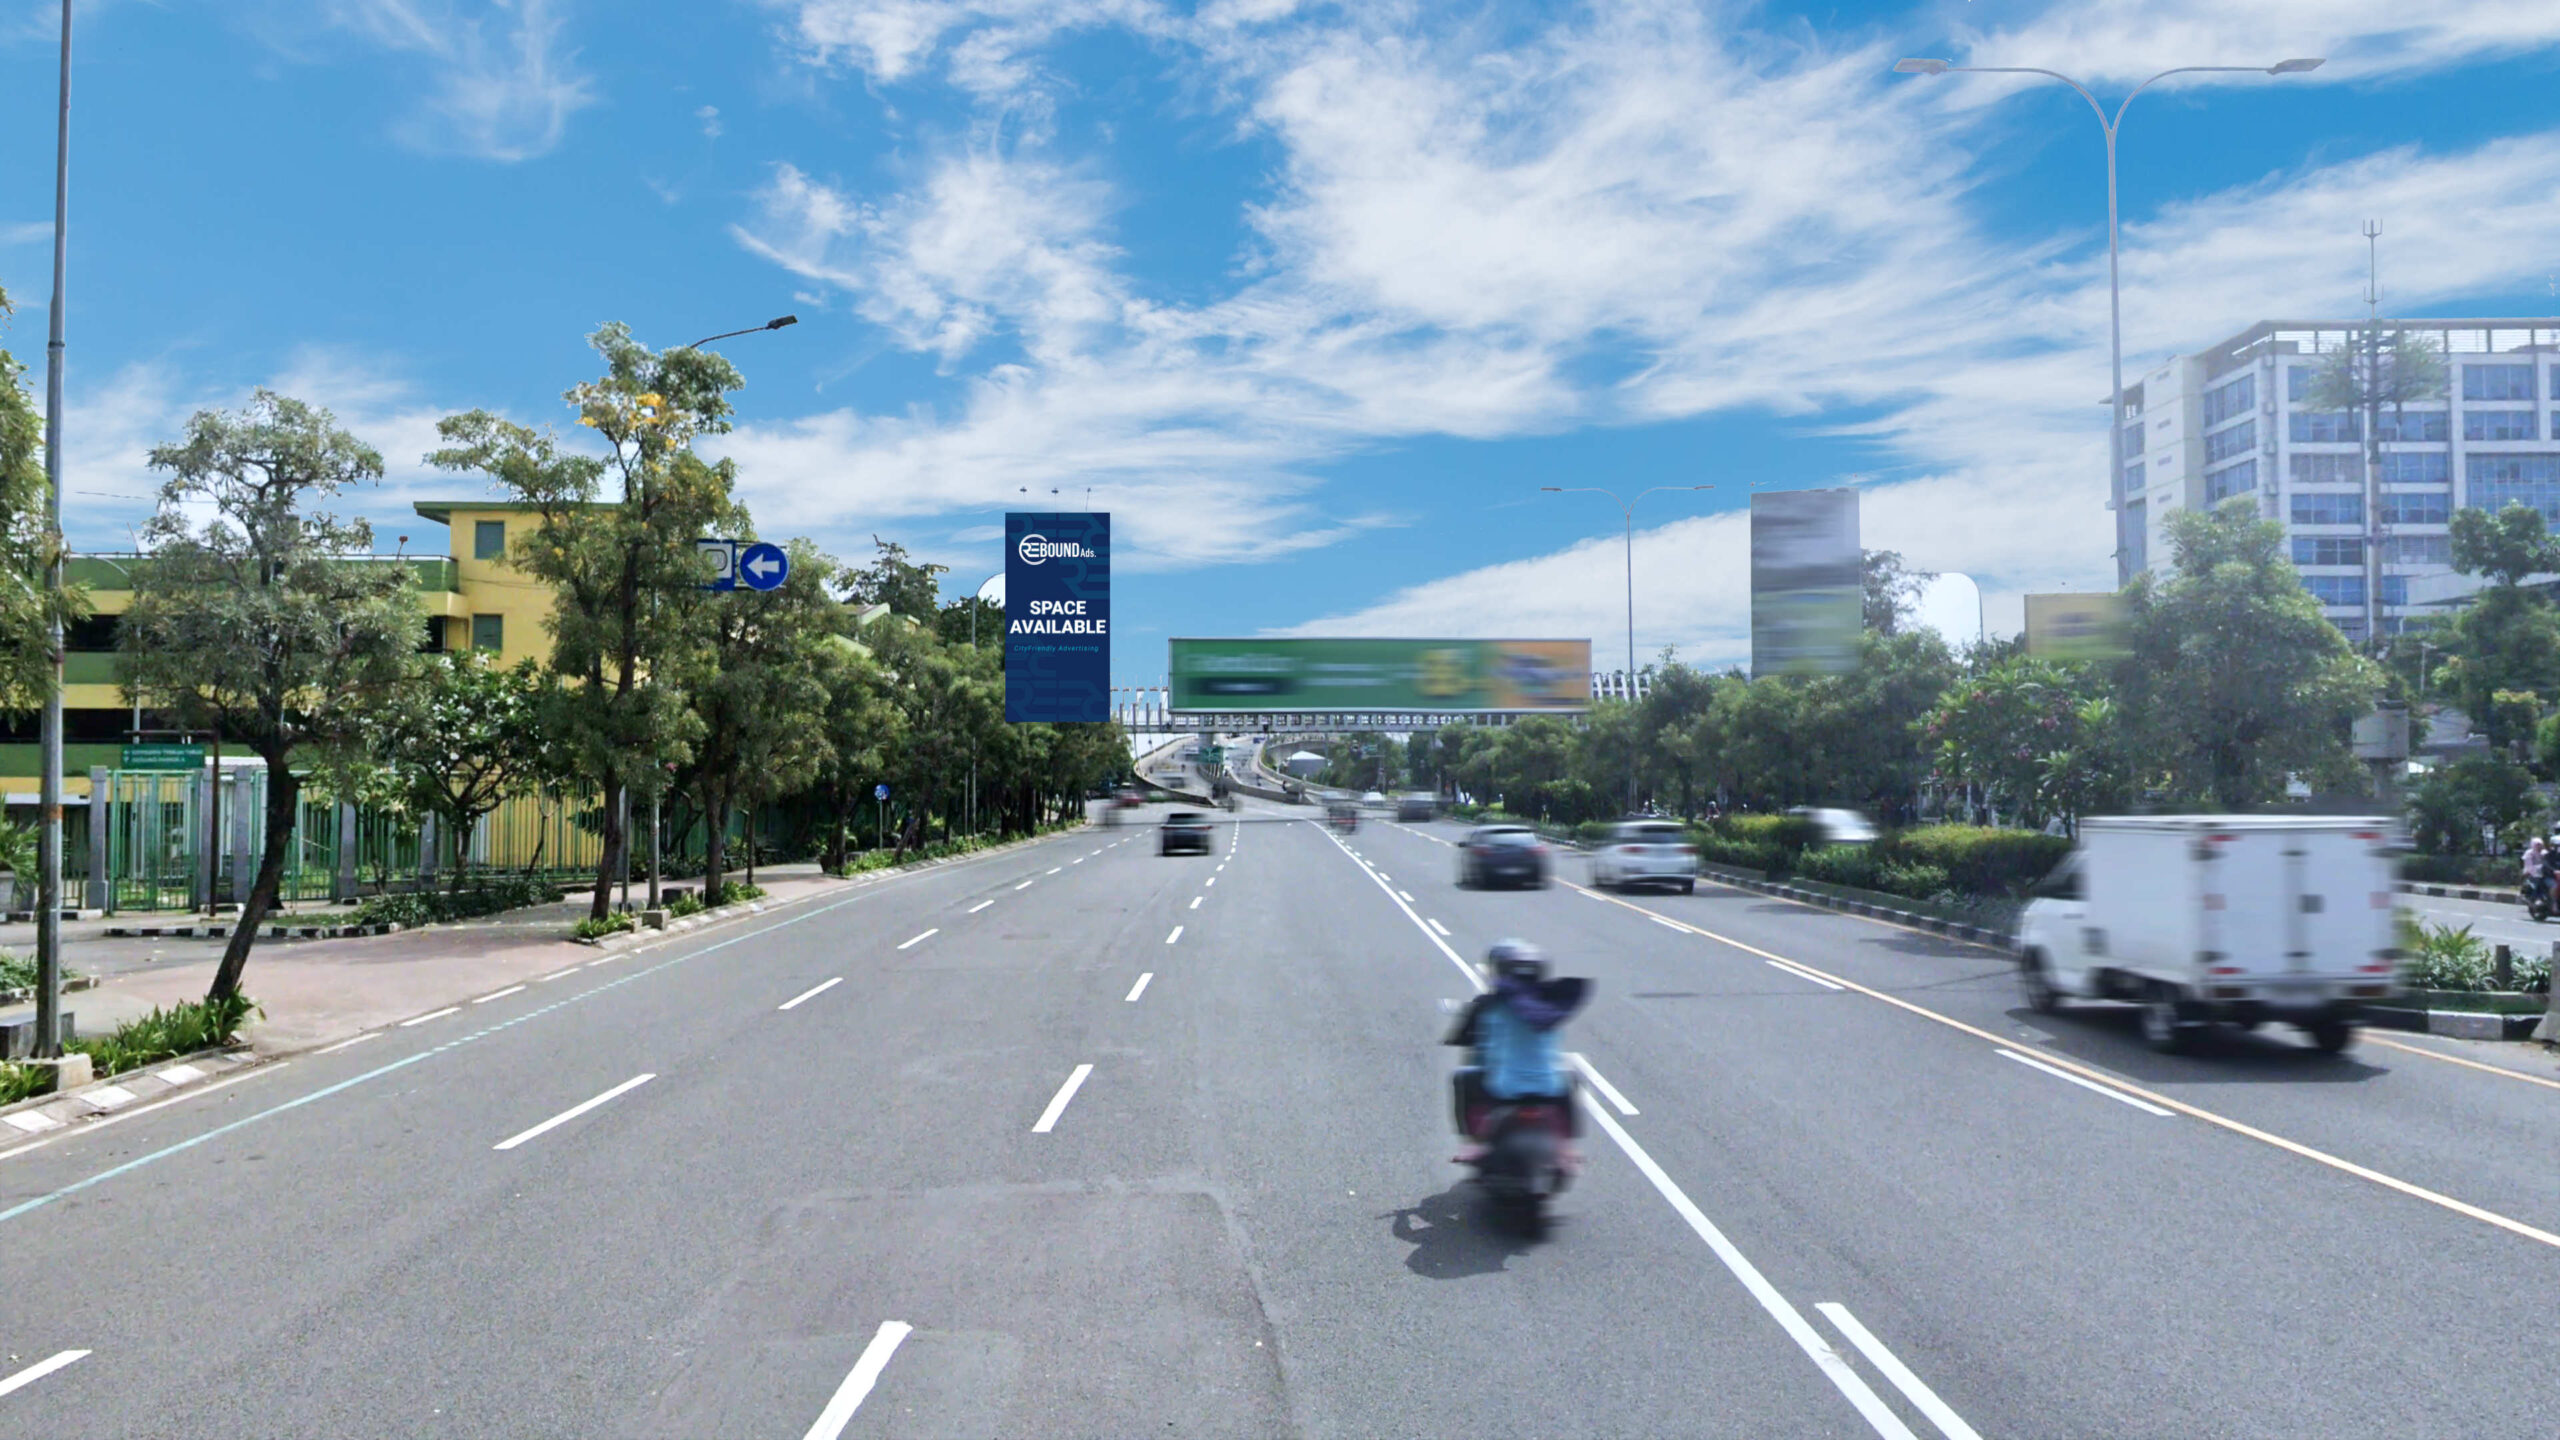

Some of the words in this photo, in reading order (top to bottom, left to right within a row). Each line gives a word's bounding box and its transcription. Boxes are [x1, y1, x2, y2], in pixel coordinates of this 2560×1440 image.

[1080, 548, 1097, 558] Ads.
[1030, 600, 1086, 615] SPACE
[1009, 619, 1106, 634] AVAILABLE
[1058, 645, 1099, 653] Advertising
